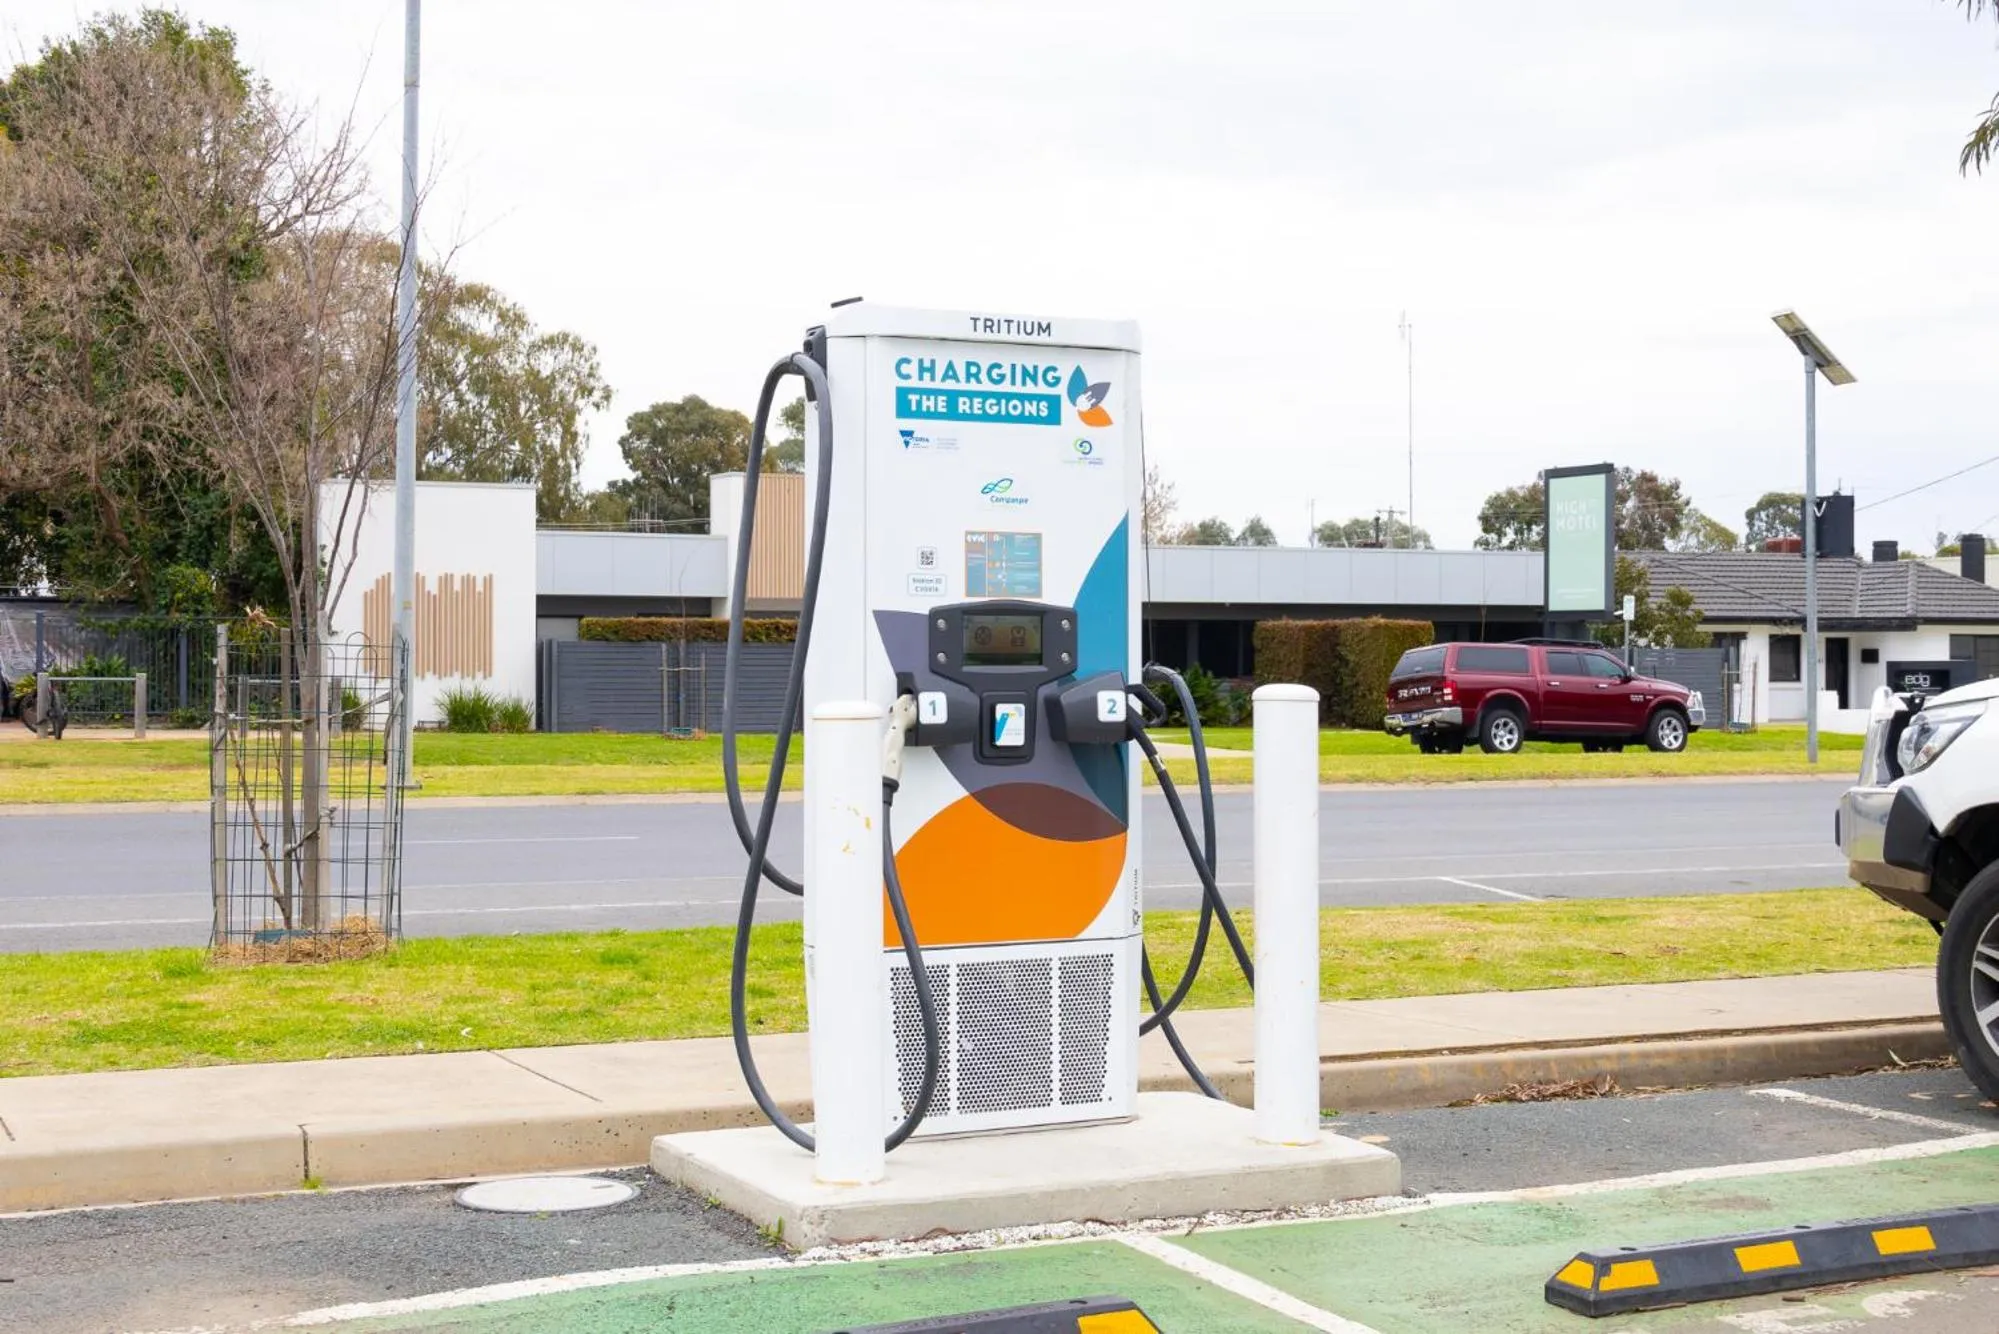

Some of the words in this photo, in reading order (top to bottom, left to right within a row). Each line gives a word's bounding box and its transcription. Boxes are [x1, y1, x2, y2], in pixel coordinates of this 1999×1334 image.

[970, 316, 1052, 337] TRITIUM
[894, 357, 1062, 389] CHARGING
[907, 394, 948, 413] THE
[957, 396, 1049, 418] REGIONS
[1398, 686, 1431, 698] RAM
[928, 700, 938, 717] 1
[1106, 698, 1118, 715] 2
